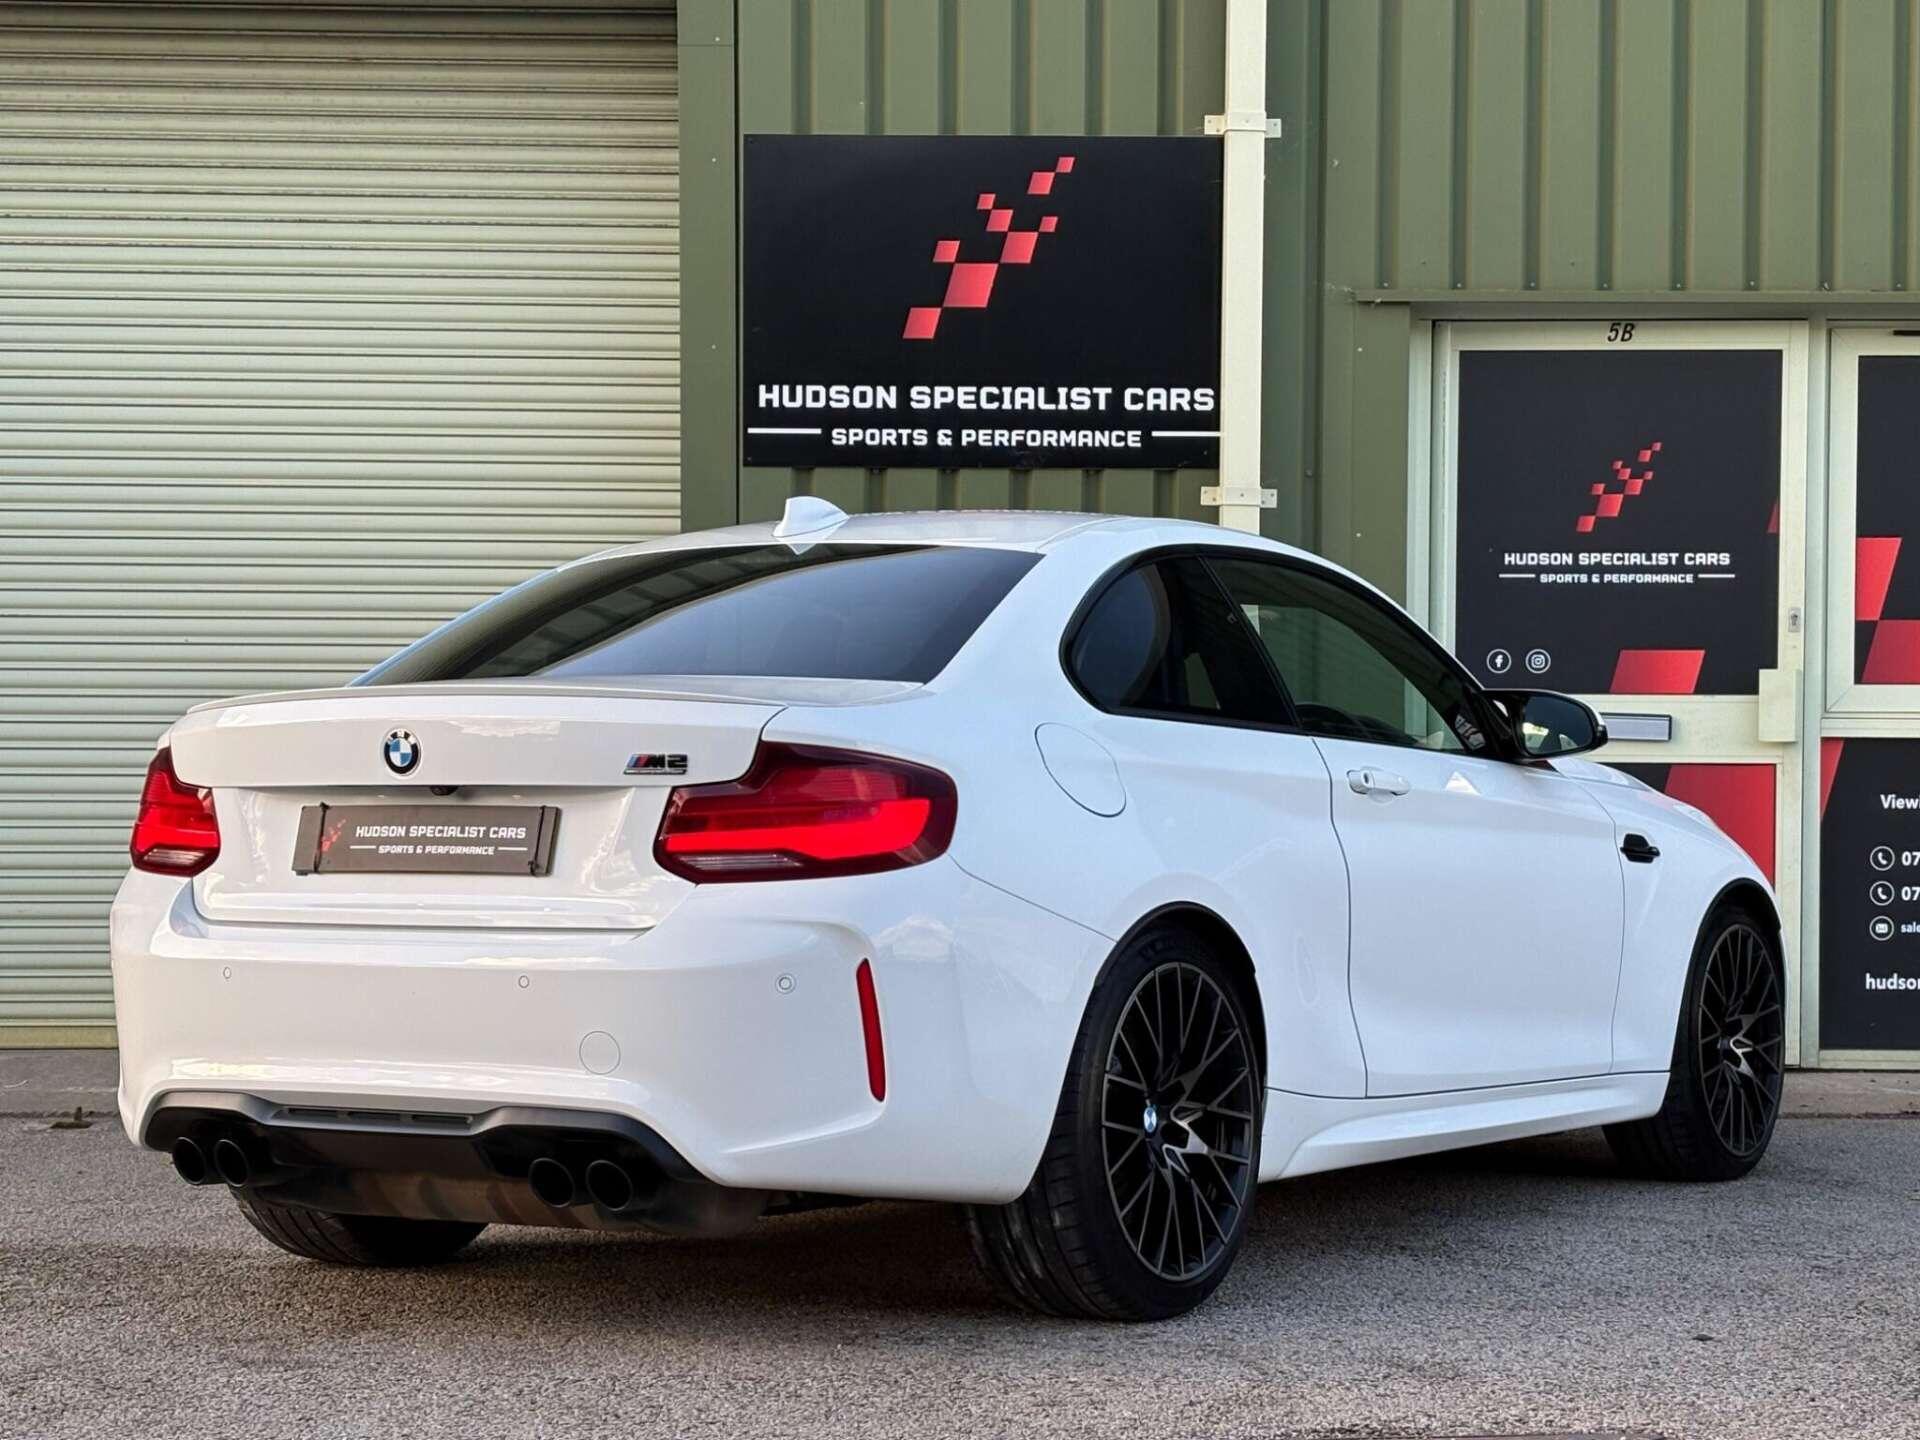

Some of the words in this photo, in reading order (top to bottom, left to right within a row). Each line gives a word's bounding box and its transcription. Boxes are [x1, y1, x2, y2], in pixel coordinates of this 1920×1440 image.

[1607, 322, 1635, 342] 5B
[758, 384, 897, 409] HUDSON
[909, 386, 1112, 411] SPECIALIST
[1123, 388, 1215, 412] CARS
[831, 427, 929, 446] SPORTS
[936, 428, 953, 447] &
[961, 428, 1142, 448] PERFORMANCE
[1504, 552, 1573, 566] HUDSON
[1578, 552, 1680, 566] SPECIALIST
[1684, 552, 1731, 566] CARS
[1539, 573, 1589, 584] SPORTS
[1591, 573, 1601, 584] &
[1603, 573, 1694, 585] PERFORMANCE
[355, 825, 407, 838] HUDSON
[408, 825, 487, 839] SPECIALIST
[489, 826, 527, 839] CARS
[377, 844, 414, 854] SPORTS
[415, 845, 423, 854] &
[424, 845, 496, 856] PERFORMANCE
[1901, 851, 1920, 867] 07
[1901, 886, 1920, 901] 07
